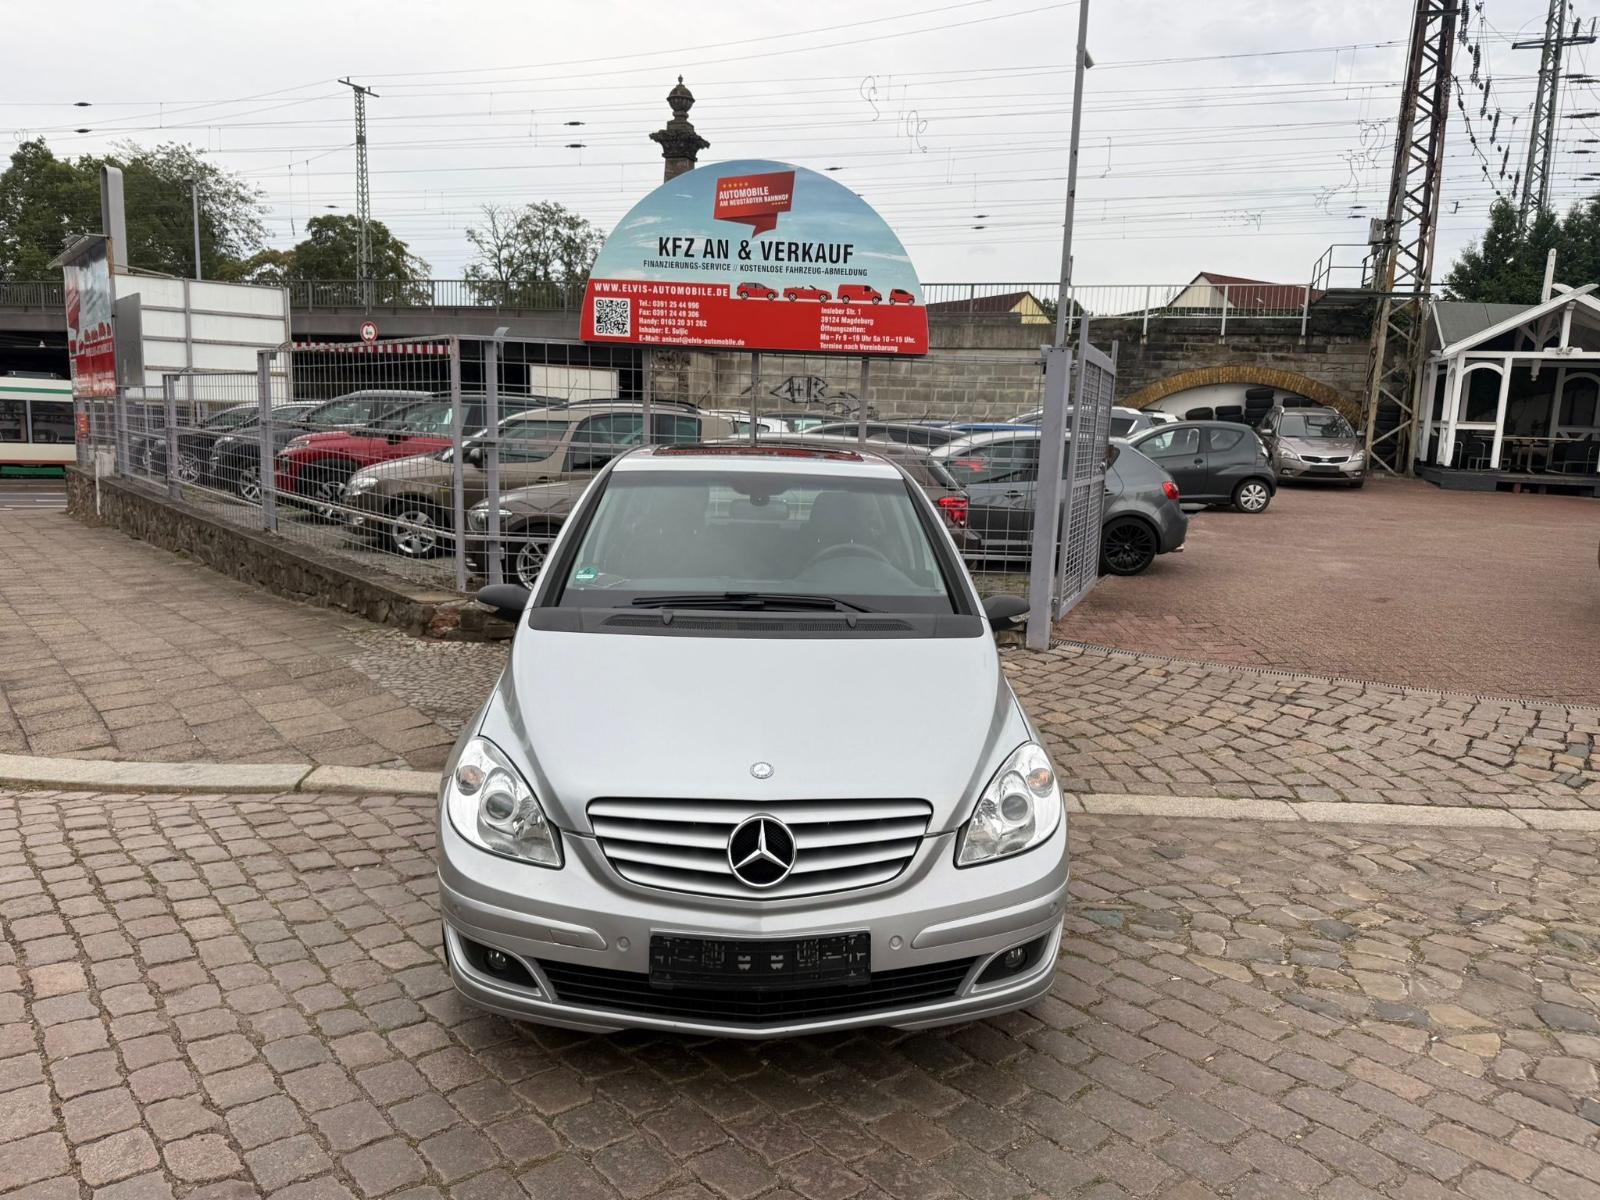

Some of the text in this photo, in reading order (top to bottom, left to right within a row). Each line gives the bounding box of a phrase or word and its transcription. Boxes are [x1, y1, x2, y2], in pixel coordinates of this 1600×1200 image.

[719, 186, 769, 200] AUTOMOBILE
[763, 194, 789, 203] BAHNHOF
[658, 237, 854, 264] KFZ AN & VERKAUF
[643, 260, 732, 271] FINANZIERUNGS-SERVICE
[739, 264, 784, 273] KOSTENLOSE
[785, 265, 868, 277] FAHRZEUG-ABMELDUNG
[594, 282, 728, 297] WWW.ELVIS-AUTOMOBILE.DE
[638, 299, 652, 307] Tel.:
[638, 308, 651, 316] Fax:
[652, 309, 668, 317] 0391
[638, 318, 660, 327] Handy:
[677, 319, 685, 327] 20
[841, 317, 874, 326] Magdeburg
[638, 326, 664, 334] Inhaber:
[820, 324, 866, 334] Öffnungszeiten:
[638, 335, 661, 343] E-Mail:
[820, 333, 830, 341] Mo
[820, 342, 843, 350] Termine
[859, 344, 898, 352] Vereinbarung
